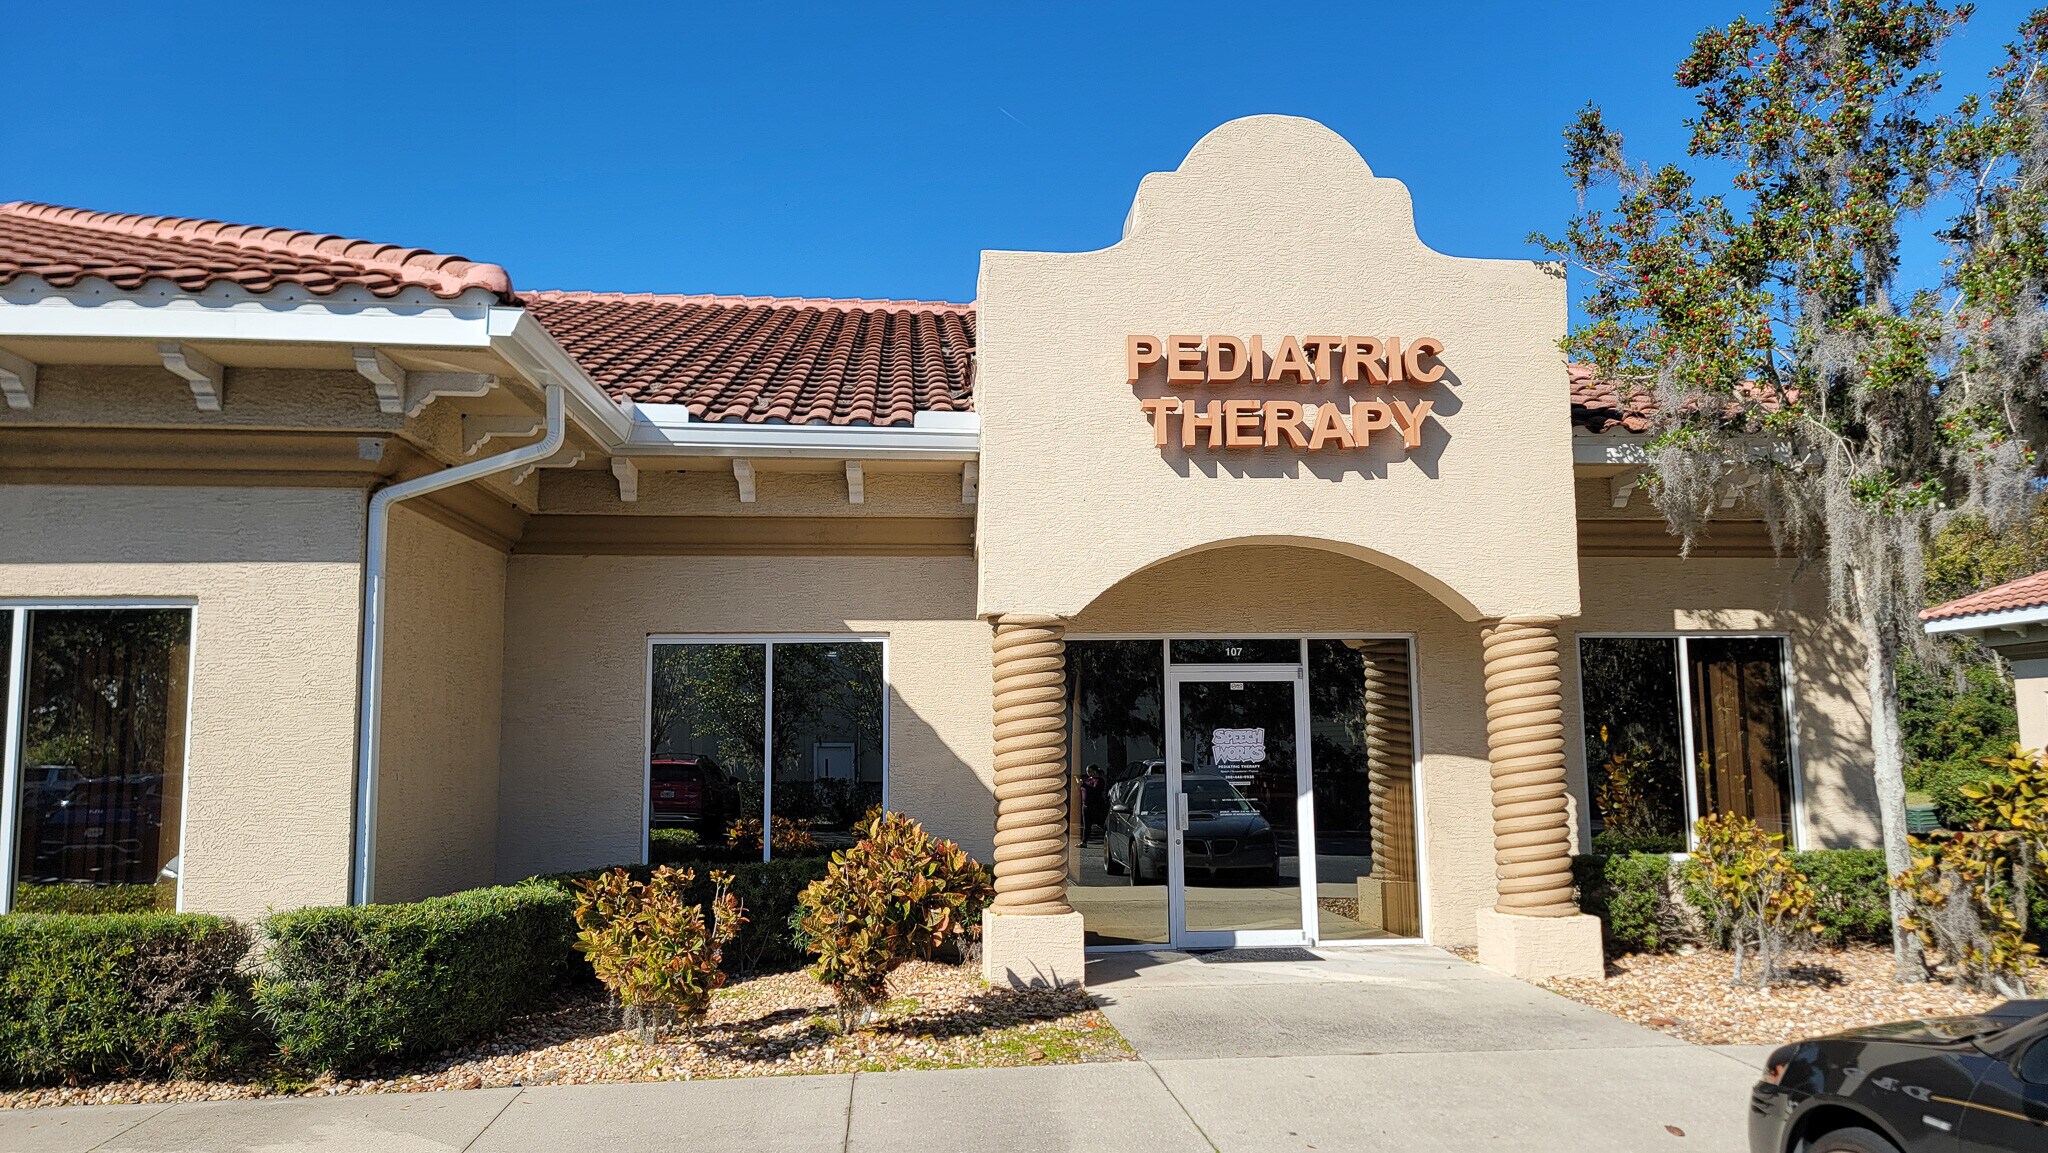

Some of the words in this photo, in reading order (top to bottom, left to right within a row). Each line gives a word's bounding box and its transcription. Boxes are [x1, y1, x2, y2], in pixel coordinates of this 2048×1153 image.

[1127, 335, 1446, 384] PEDIATRIC
[1141, 399, 1434, 450] THERAPY
[1225, 647, 1243, 656] 107
[1212, 728, 1264, 745] SPEECH
[1212, 745, 1266, 764] WORKS
